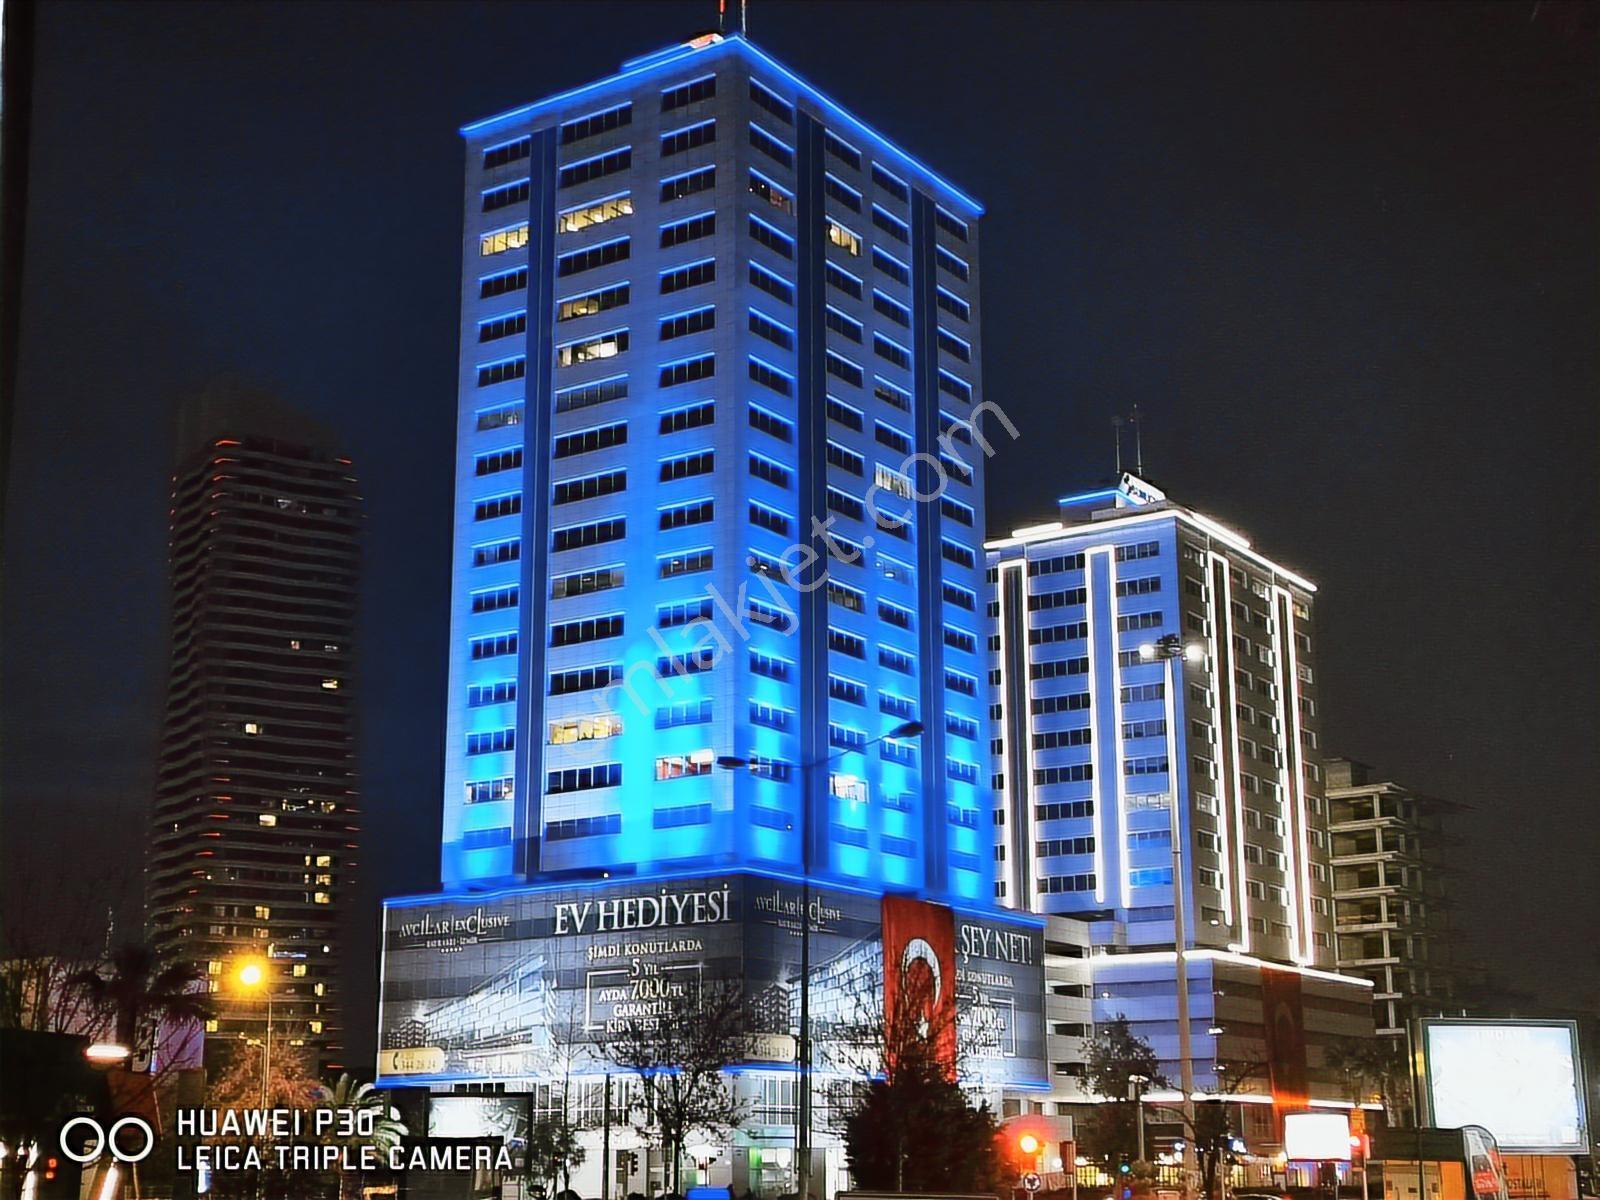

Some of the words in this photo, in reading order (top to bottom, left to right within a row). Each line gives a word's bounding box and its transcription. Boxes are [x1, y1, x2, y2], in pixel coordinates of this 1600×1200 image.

[553, 902, 593, 935] EV
[596, 883, 733, 932] HEDİYESİ
[398, 913, 450, 938] AVCILAR
[586, 943, 620, 961] ŞİMDİ
[624, 939, 704, 957] KONUTLARDA
[961, 924, 991, 964] ŞEY
[994, 929, 1033, 965] NET!
[630, 957, 641, 977] 5
[598, 987, 628, 1002] AYDA
[671, 984, 685, 998] TL
